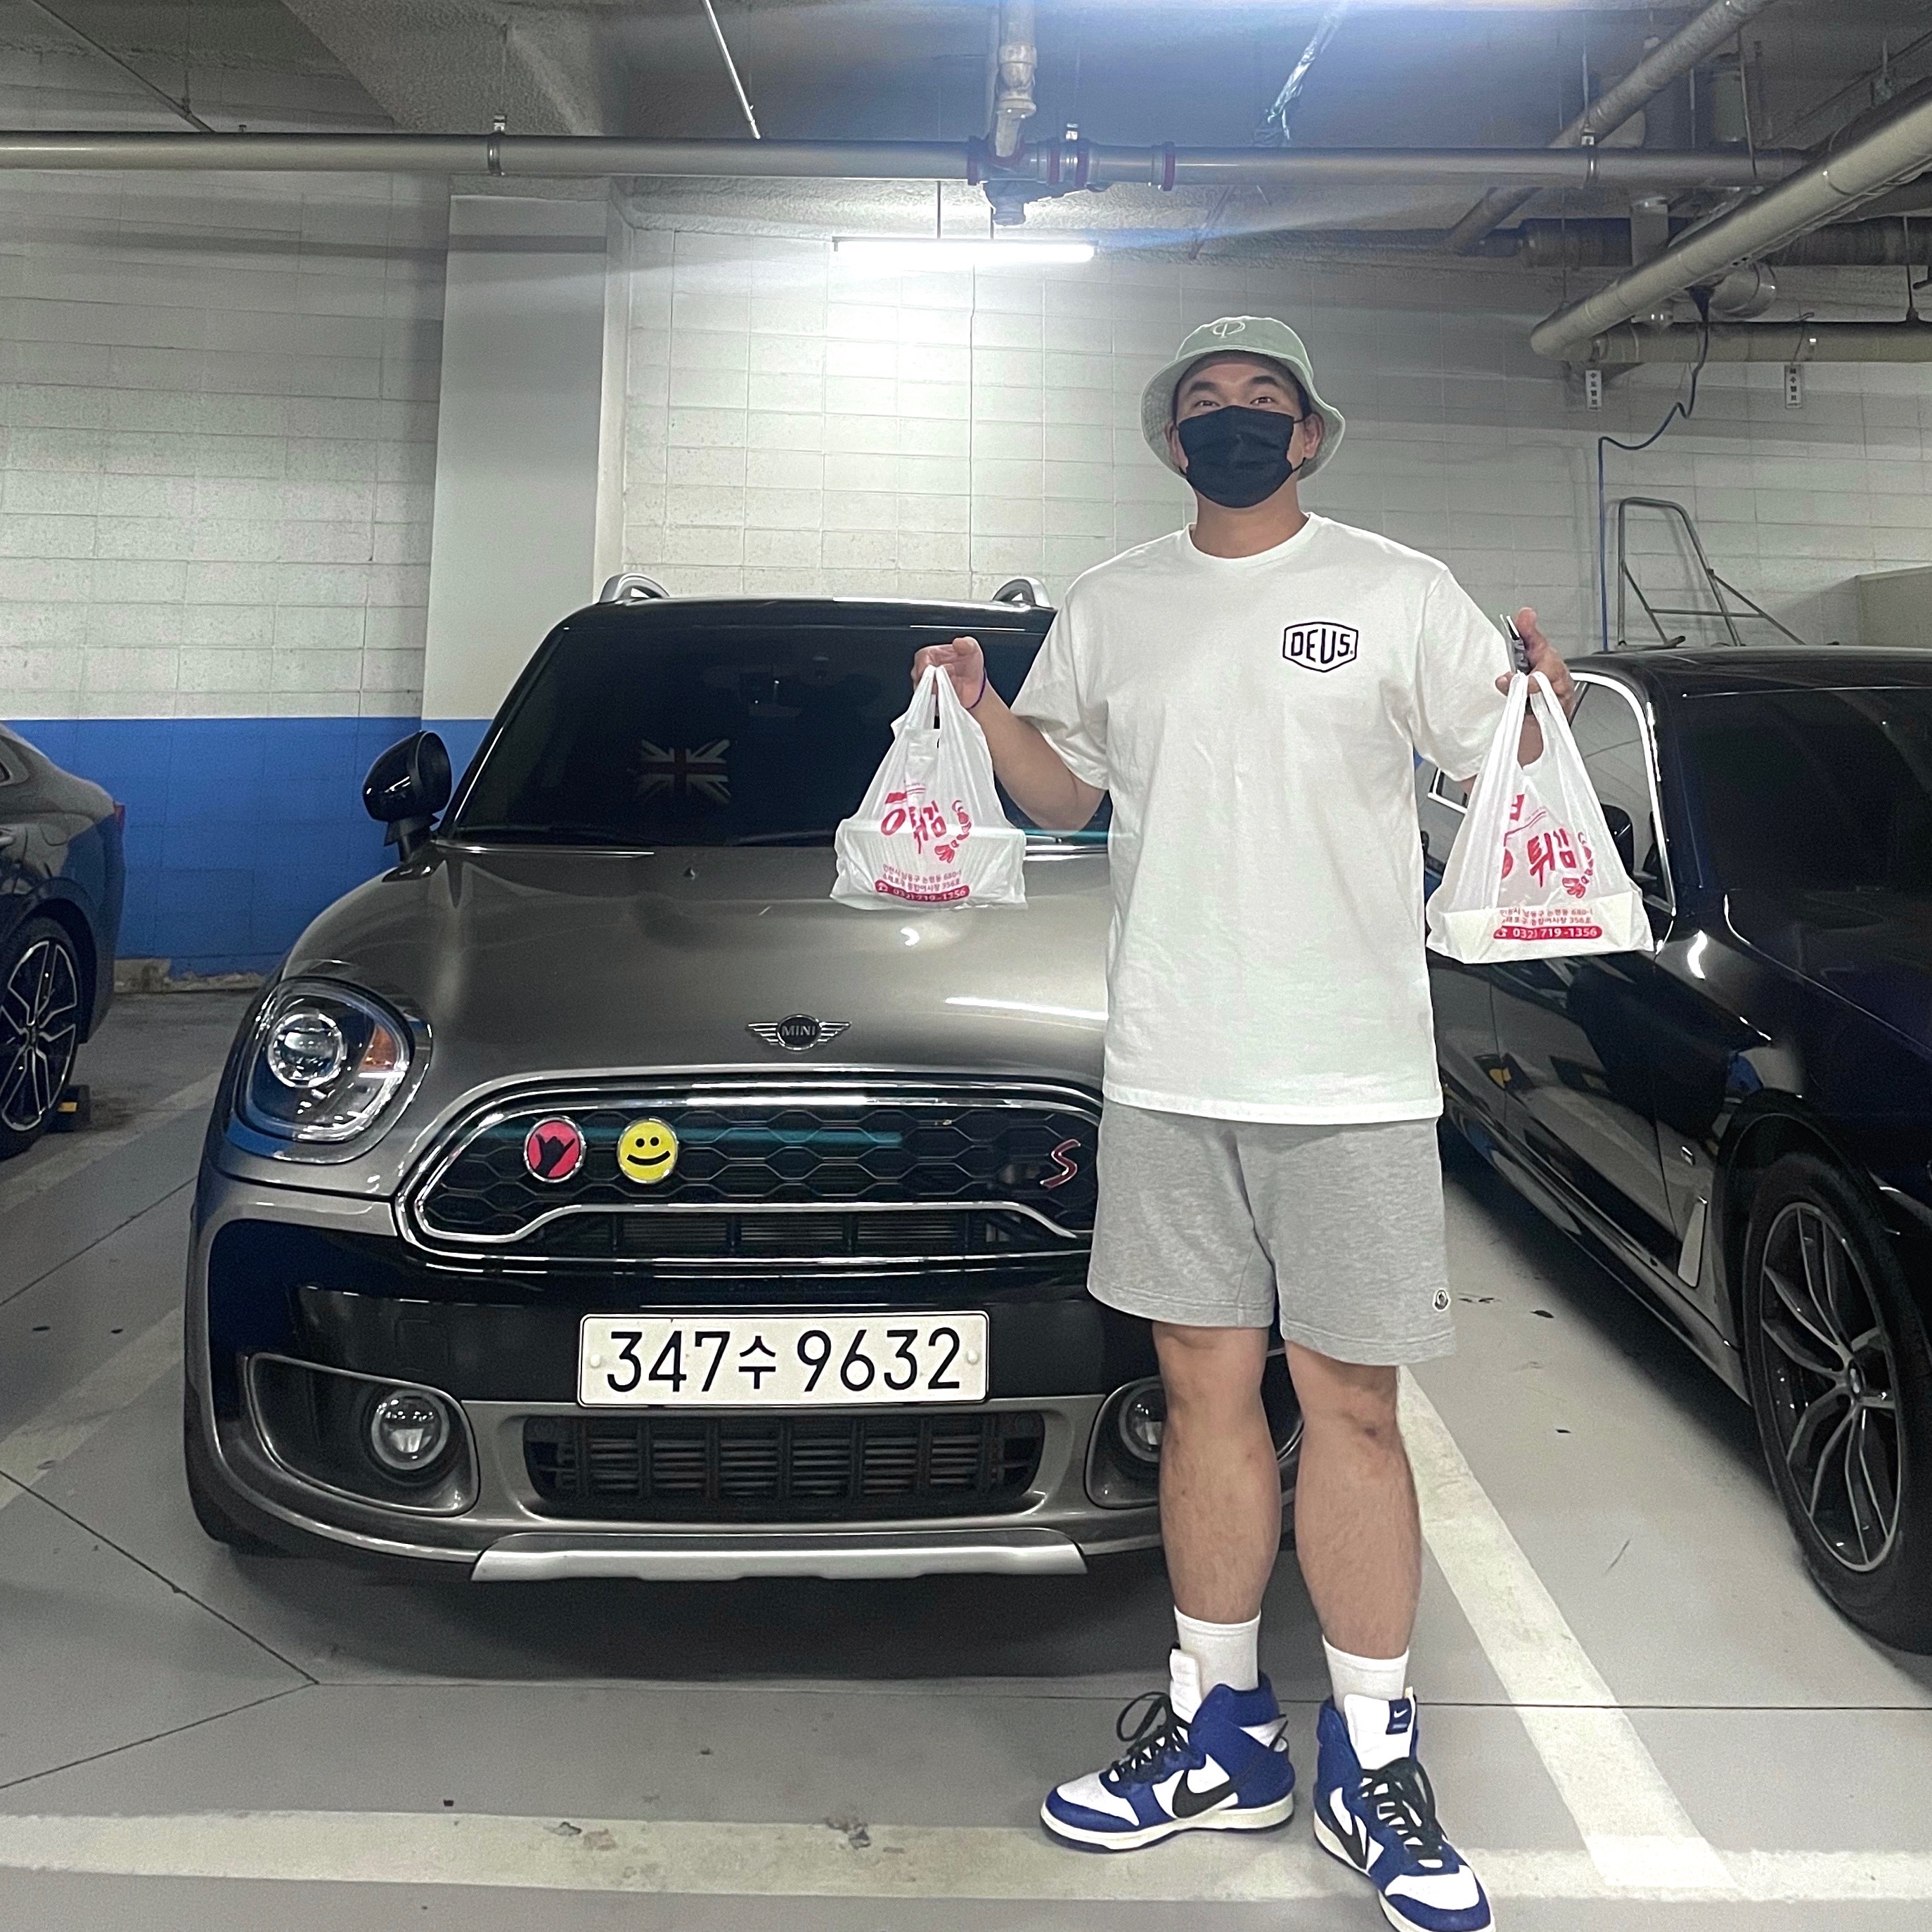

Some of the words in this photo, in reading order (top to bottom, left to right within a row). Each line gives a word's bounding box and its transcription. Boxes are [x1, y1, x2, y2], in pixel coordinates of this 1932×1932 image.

[1527, 828, 1576, 887] 튀김
[782, 1024, 816, 1036] MINI
[607, 1329, 776, 1392] 347수
[797, 1327, 960, 1392] 9632
